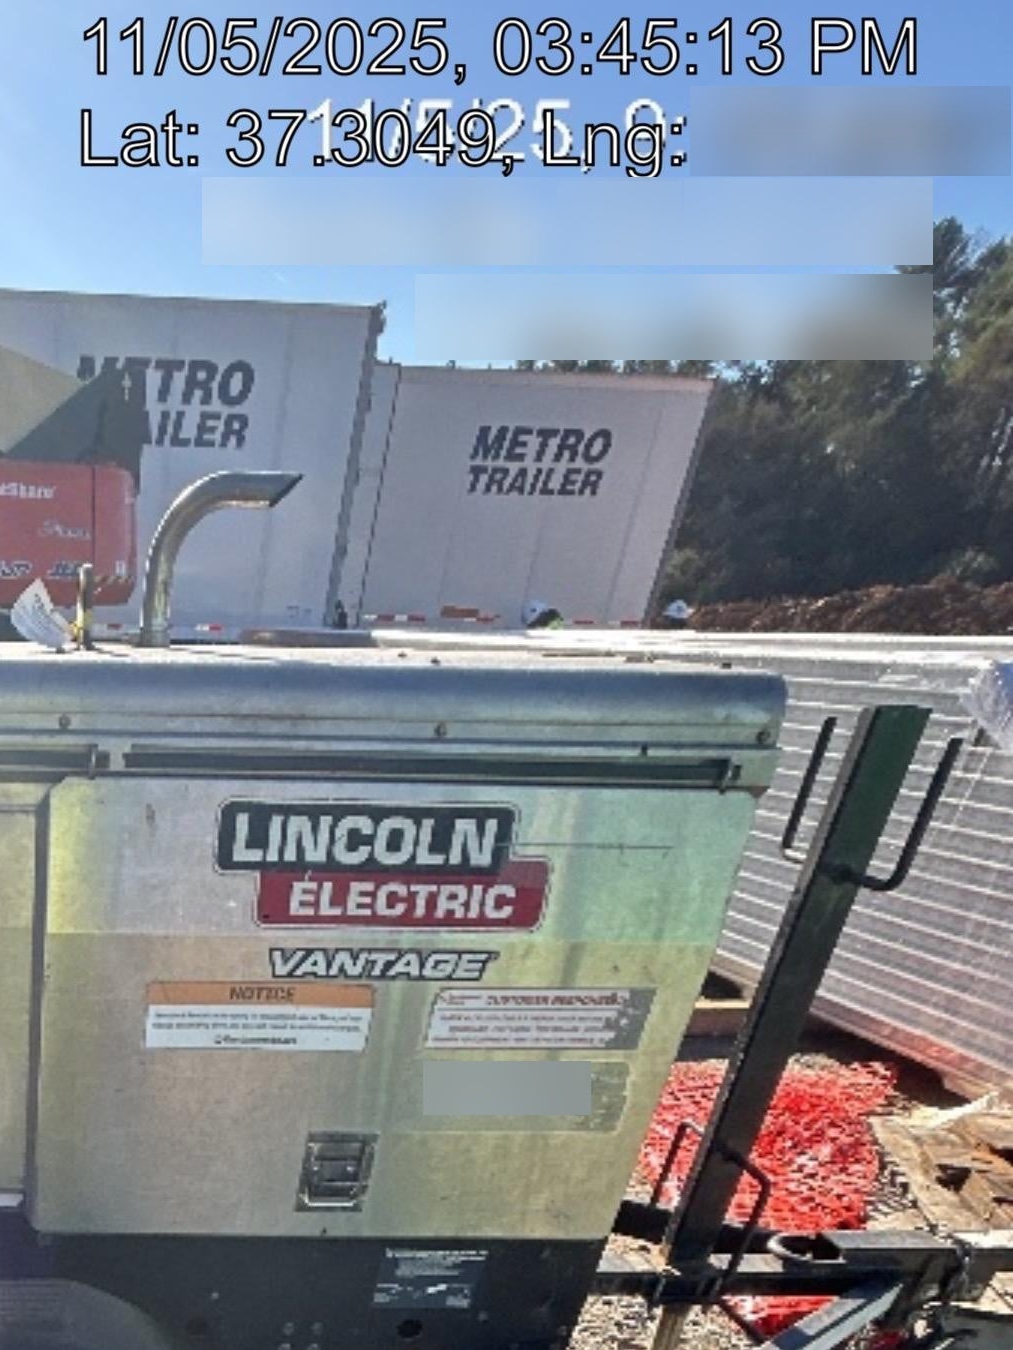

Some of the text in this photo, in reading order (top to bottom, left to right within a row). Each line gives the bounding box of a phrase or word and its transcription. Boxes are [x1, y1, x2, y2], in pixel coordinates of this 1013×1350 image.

[469, 425, 613, 464] METRO
[467, 464, 604, 496] TRAILER
[232, 811, 498, 867] LINCOLN
[289, 881, 516, 920] ELECTRIC
[269, 947, 494, 981] VANTAGE
[229, 986, 295, 1001] NOTICE
